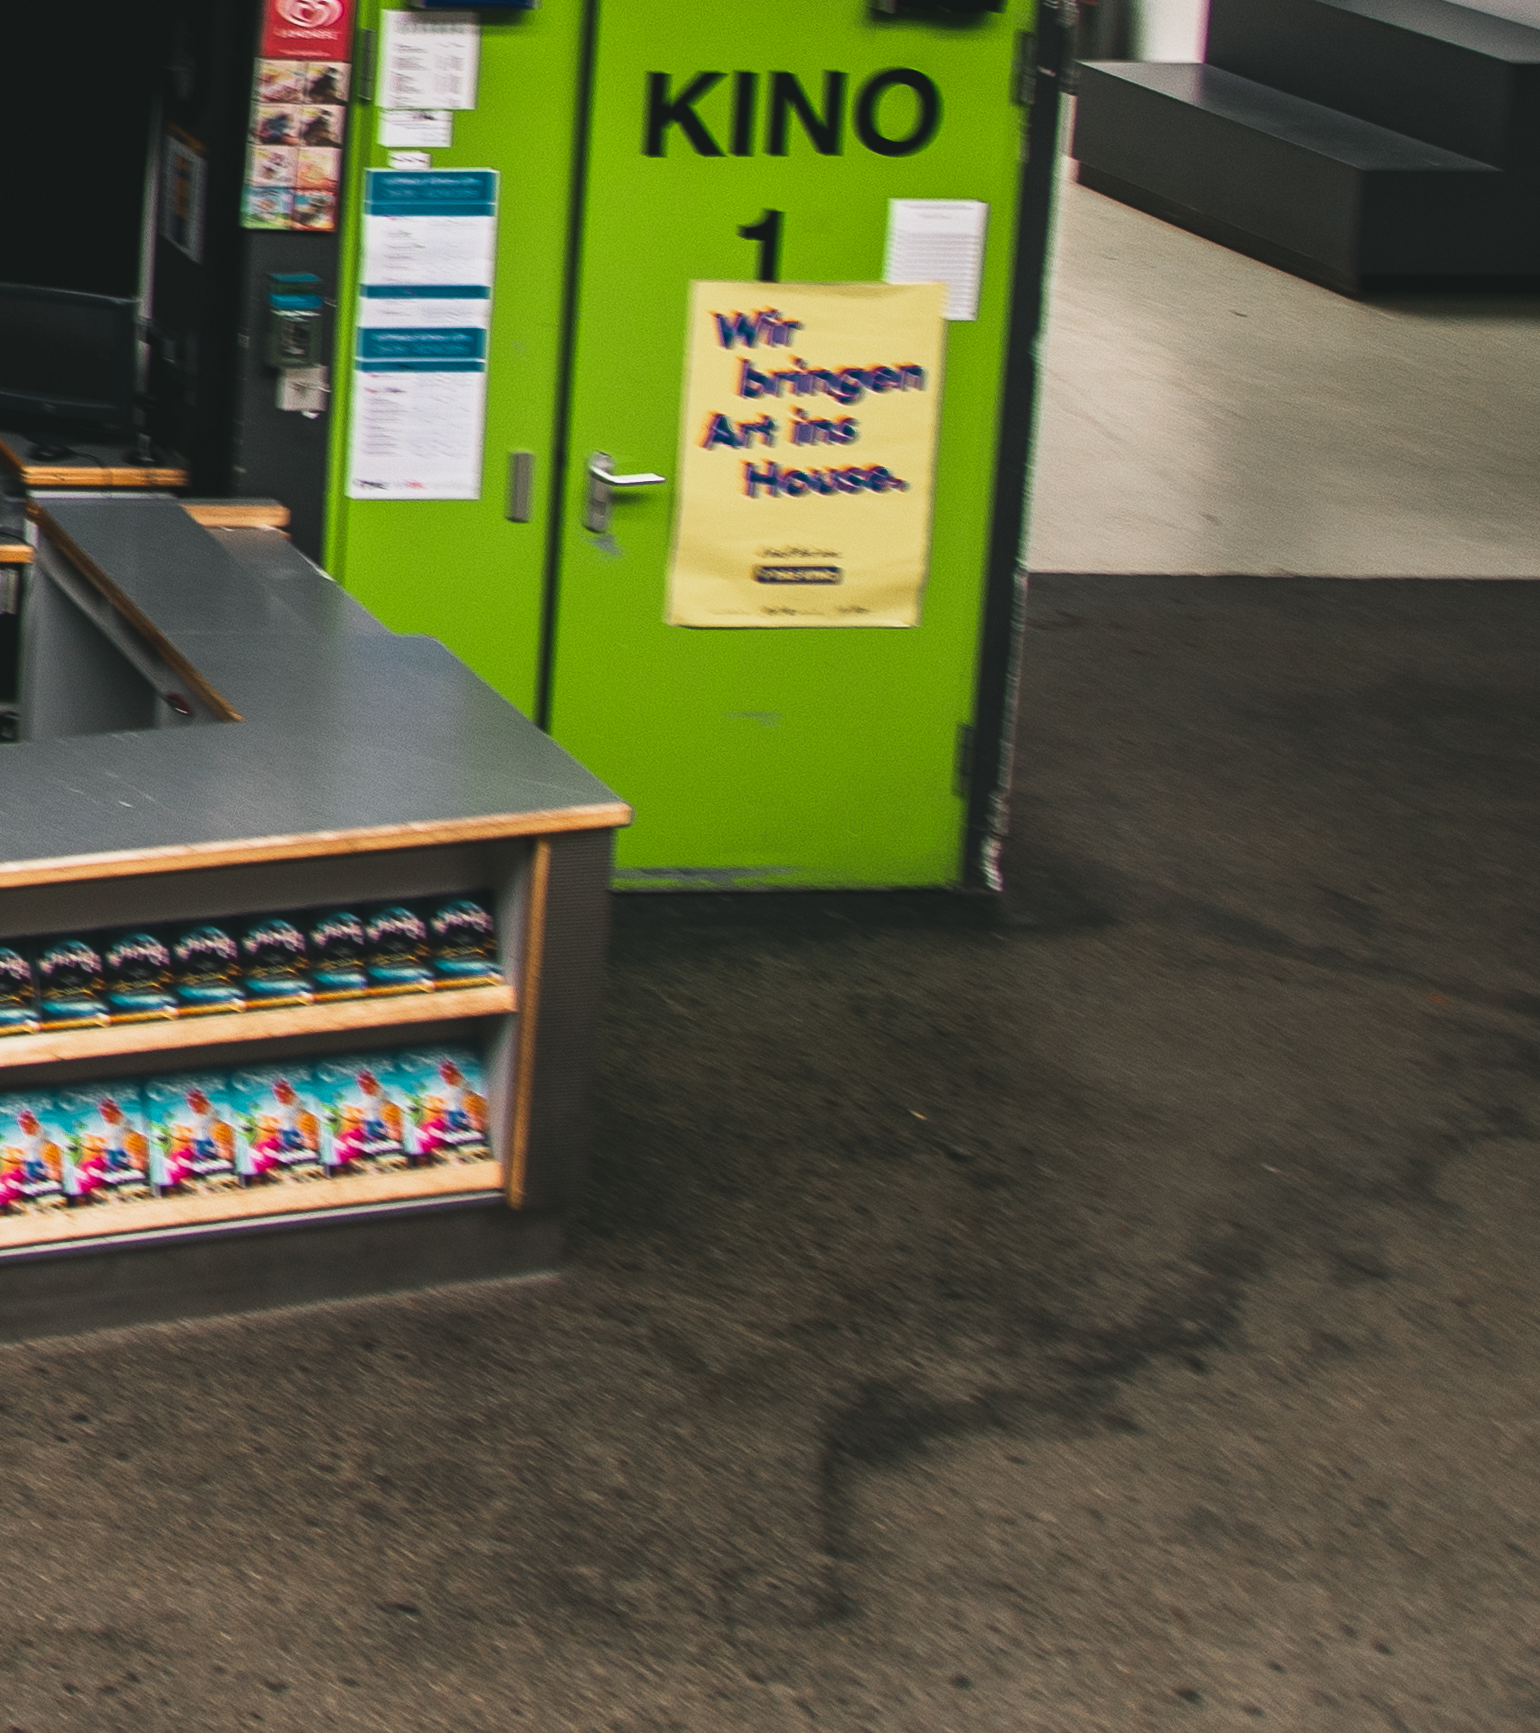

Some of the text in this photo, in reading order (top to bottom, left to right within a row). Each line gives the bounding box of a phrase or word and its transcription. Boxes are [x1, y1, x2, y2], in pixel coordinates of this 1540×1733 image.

[639, 66, 946, 159] KINO
[735, 207, 787, 284] 1
[708, 306, 805, 350] Wir
[736, 355, 929, 405] bringen
[696, 404, 862, 451] Art ins
[739, 458, 911, 499] House.
